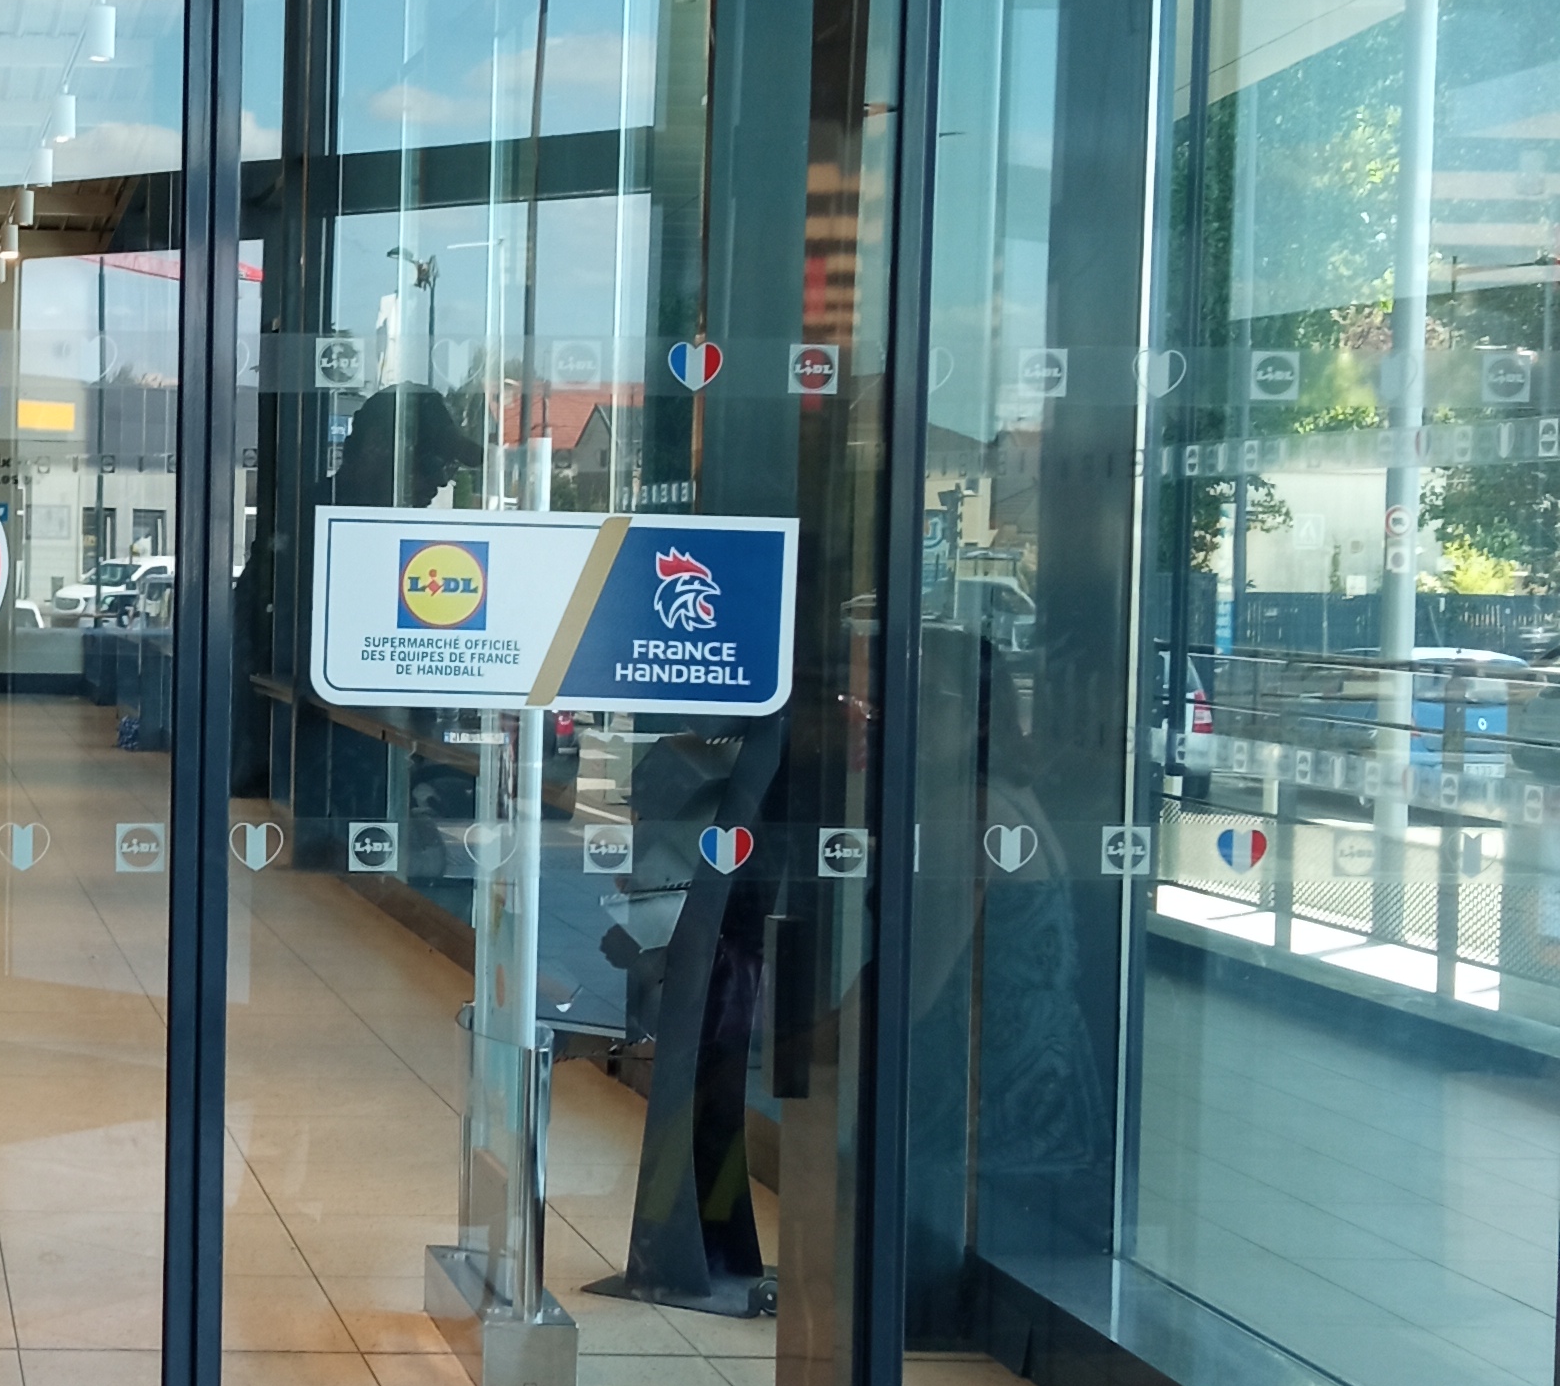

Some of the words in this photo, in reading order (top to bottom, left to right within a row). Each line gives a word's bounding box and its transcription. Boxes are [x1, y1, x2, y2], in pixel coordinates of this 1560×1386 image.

[364, 635, 460, 649] SUPERMARCHÉ
[465, 639, 520, 651] OFFICIEL
[361, 649, 385, 661] DES
[390, 646, 444, 662] ÉQUIPES
[449, 651, 466, 663] DE
[470, 653, 519, 665] FRANCE
[396, 664, 413, 675] DE
[417, 664, 483, 677] HANDBALL
